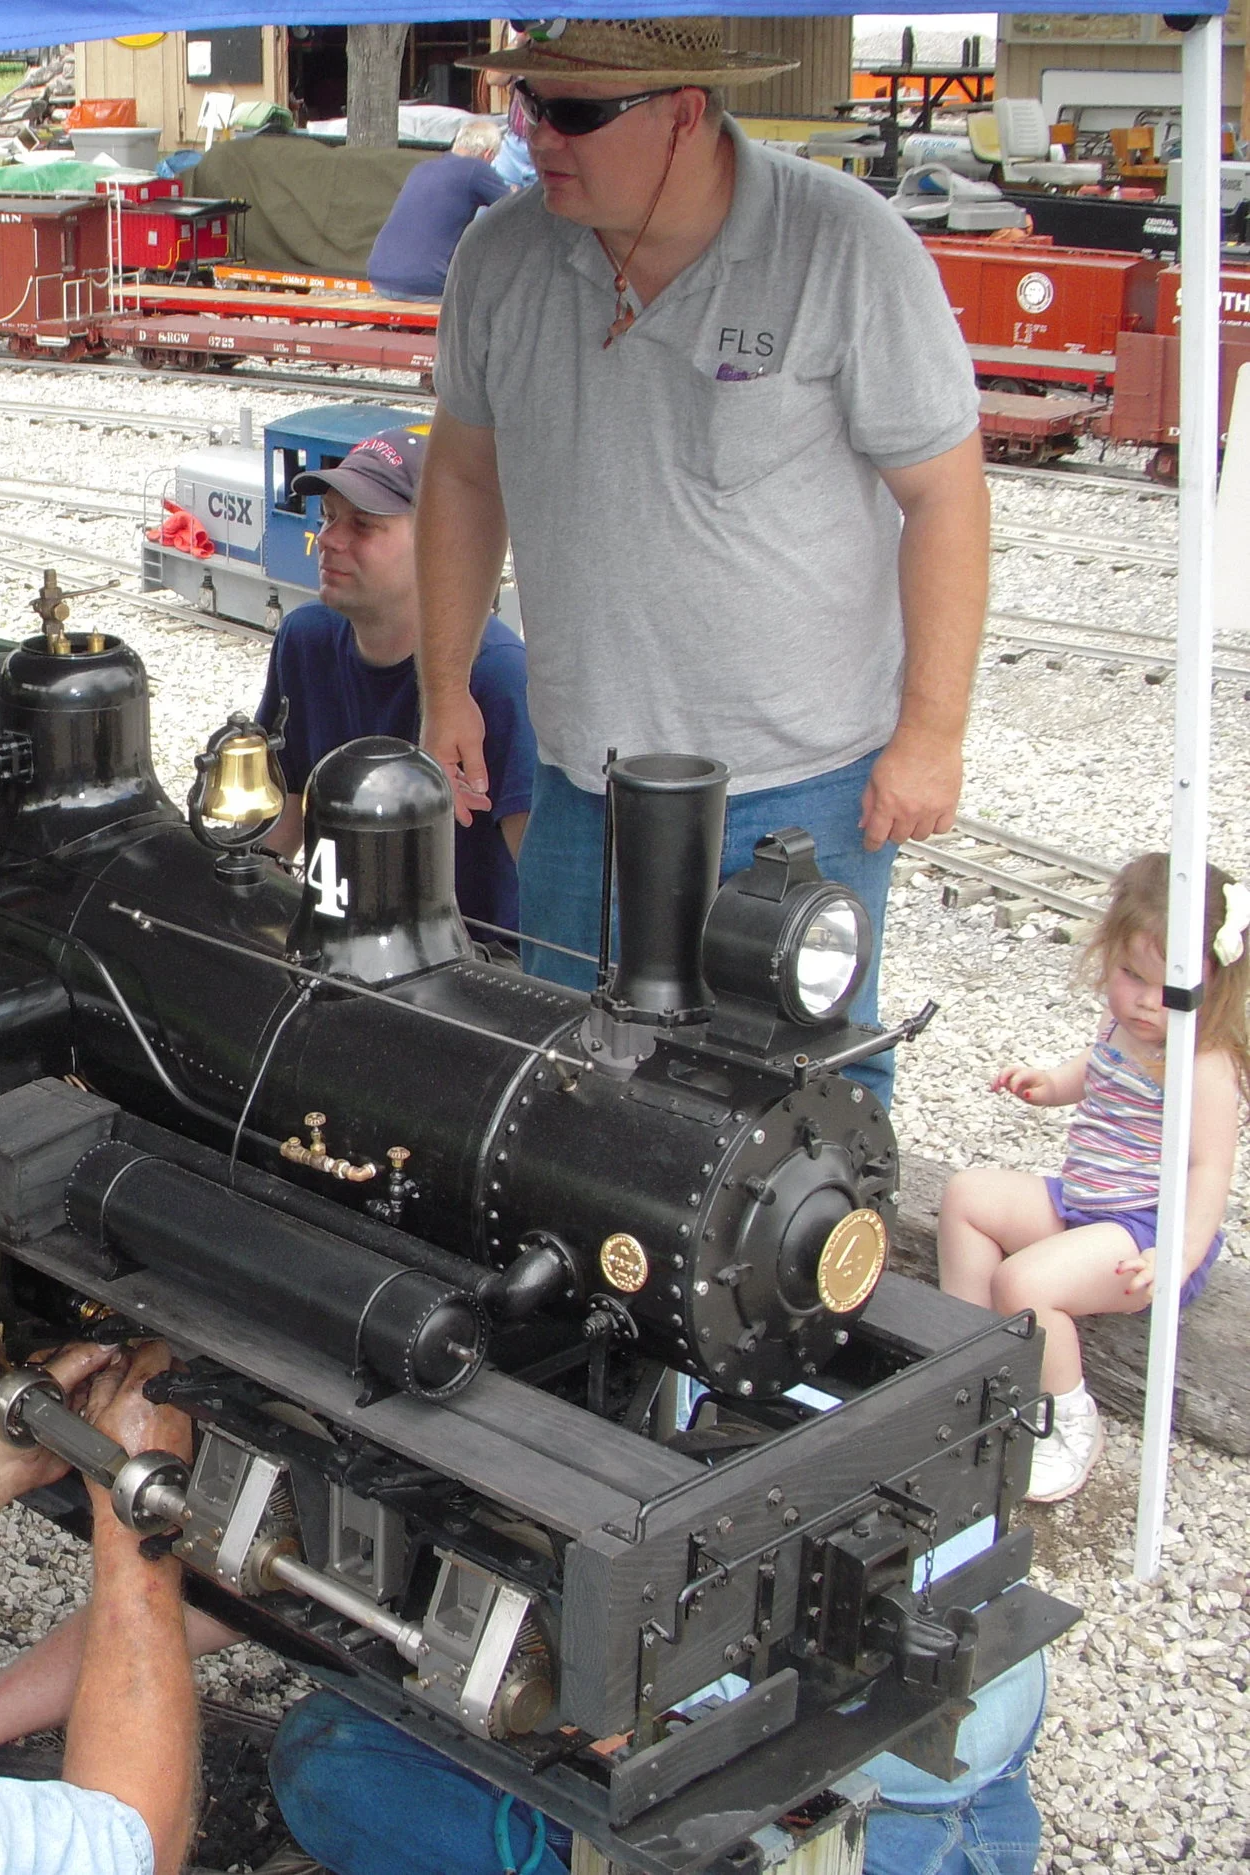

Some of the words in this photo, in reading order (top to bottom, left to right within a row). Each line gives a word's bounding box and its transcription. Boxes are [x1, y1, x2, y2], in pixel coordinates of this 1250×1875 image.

[208, 337, 235, 348] 6725
[718, 327, 774, 357] FLS
[208, 491, 253, 525] CSX
[307, 837, 349, 918] 4
